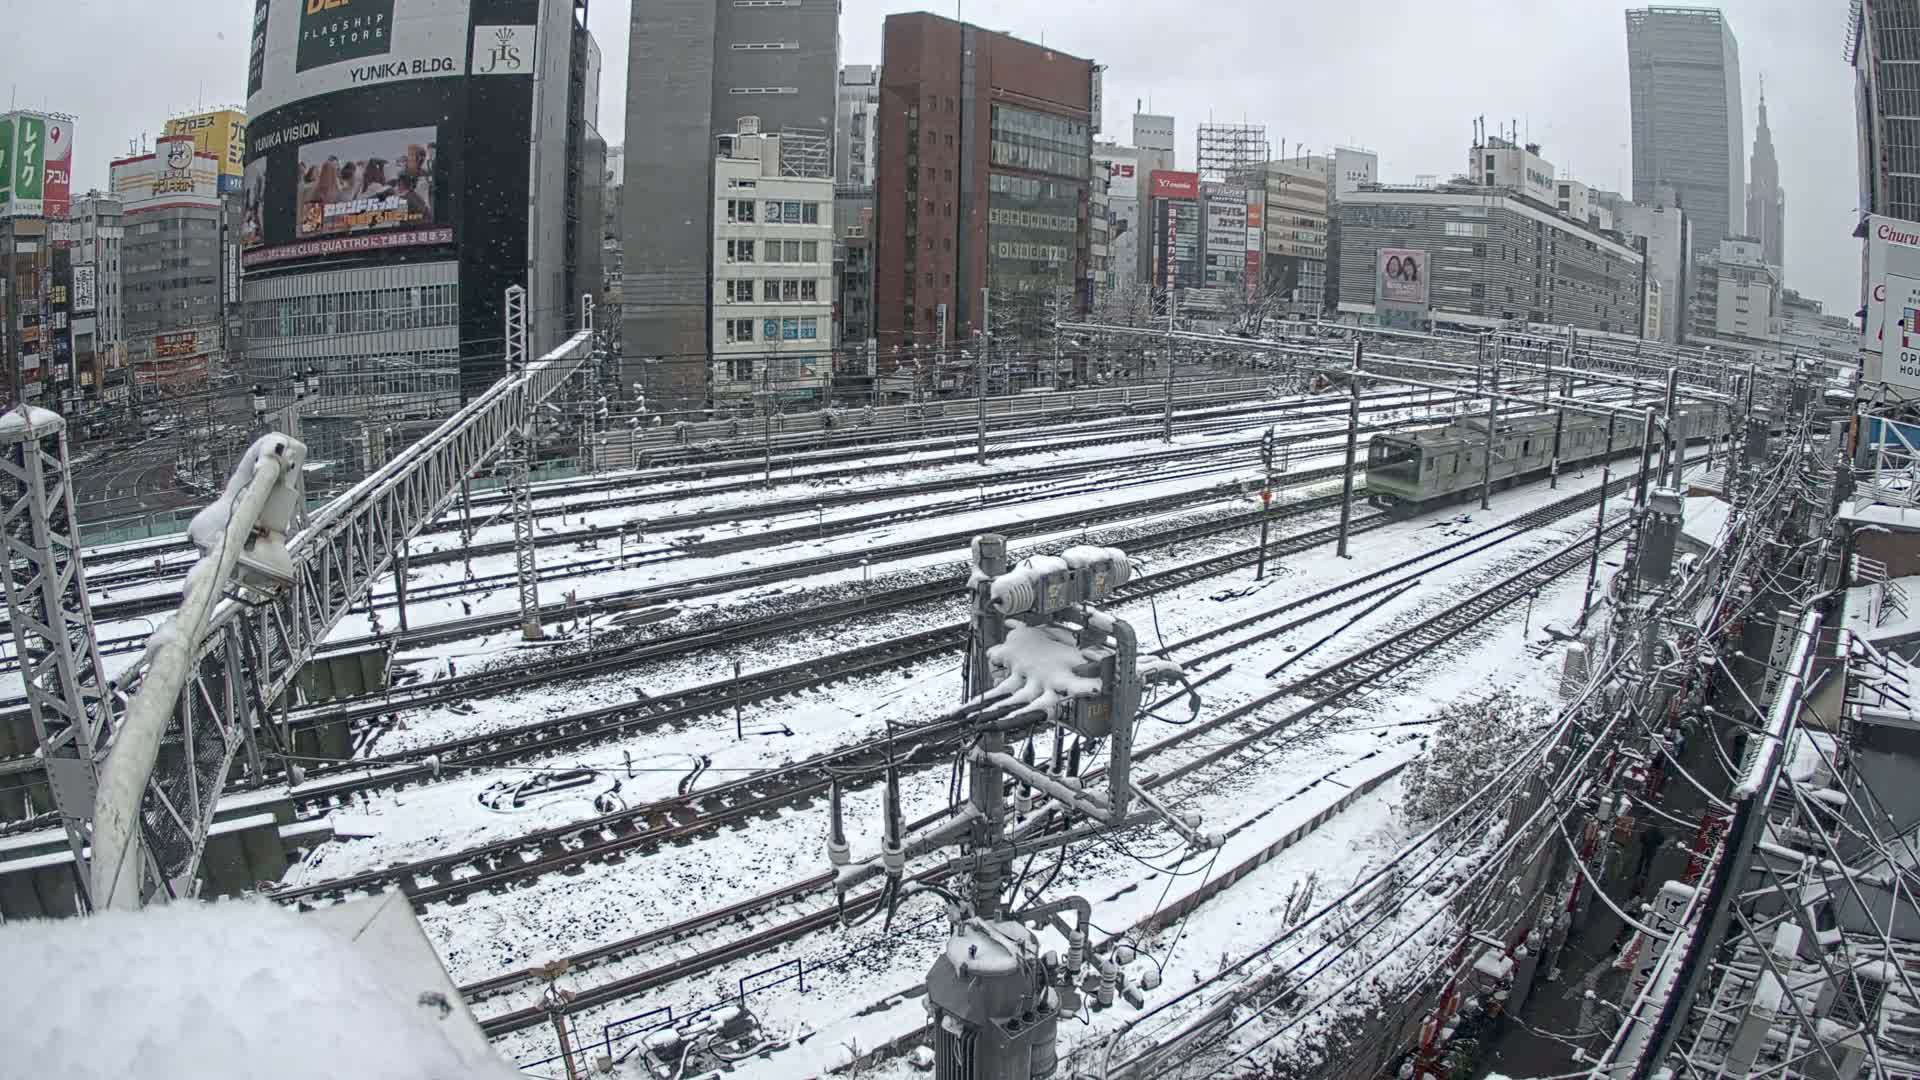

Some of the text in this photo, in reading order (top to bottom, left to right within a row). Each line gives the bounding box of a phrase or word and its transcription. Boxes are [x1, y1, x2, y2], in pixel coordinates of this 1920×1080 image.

[304, 14, 383, 40] FLAGSHIP
[329, 28, 382, 47] STORE
[350, 57, 456, 82] YUNIKA BLDG.
[255, 119, 320, 153] YUNIKA VISION
[22, 121, 37, 187] レイク
[46, 169, 69, 185] アコム
[321, 237, 369, 256] QUATTRO
